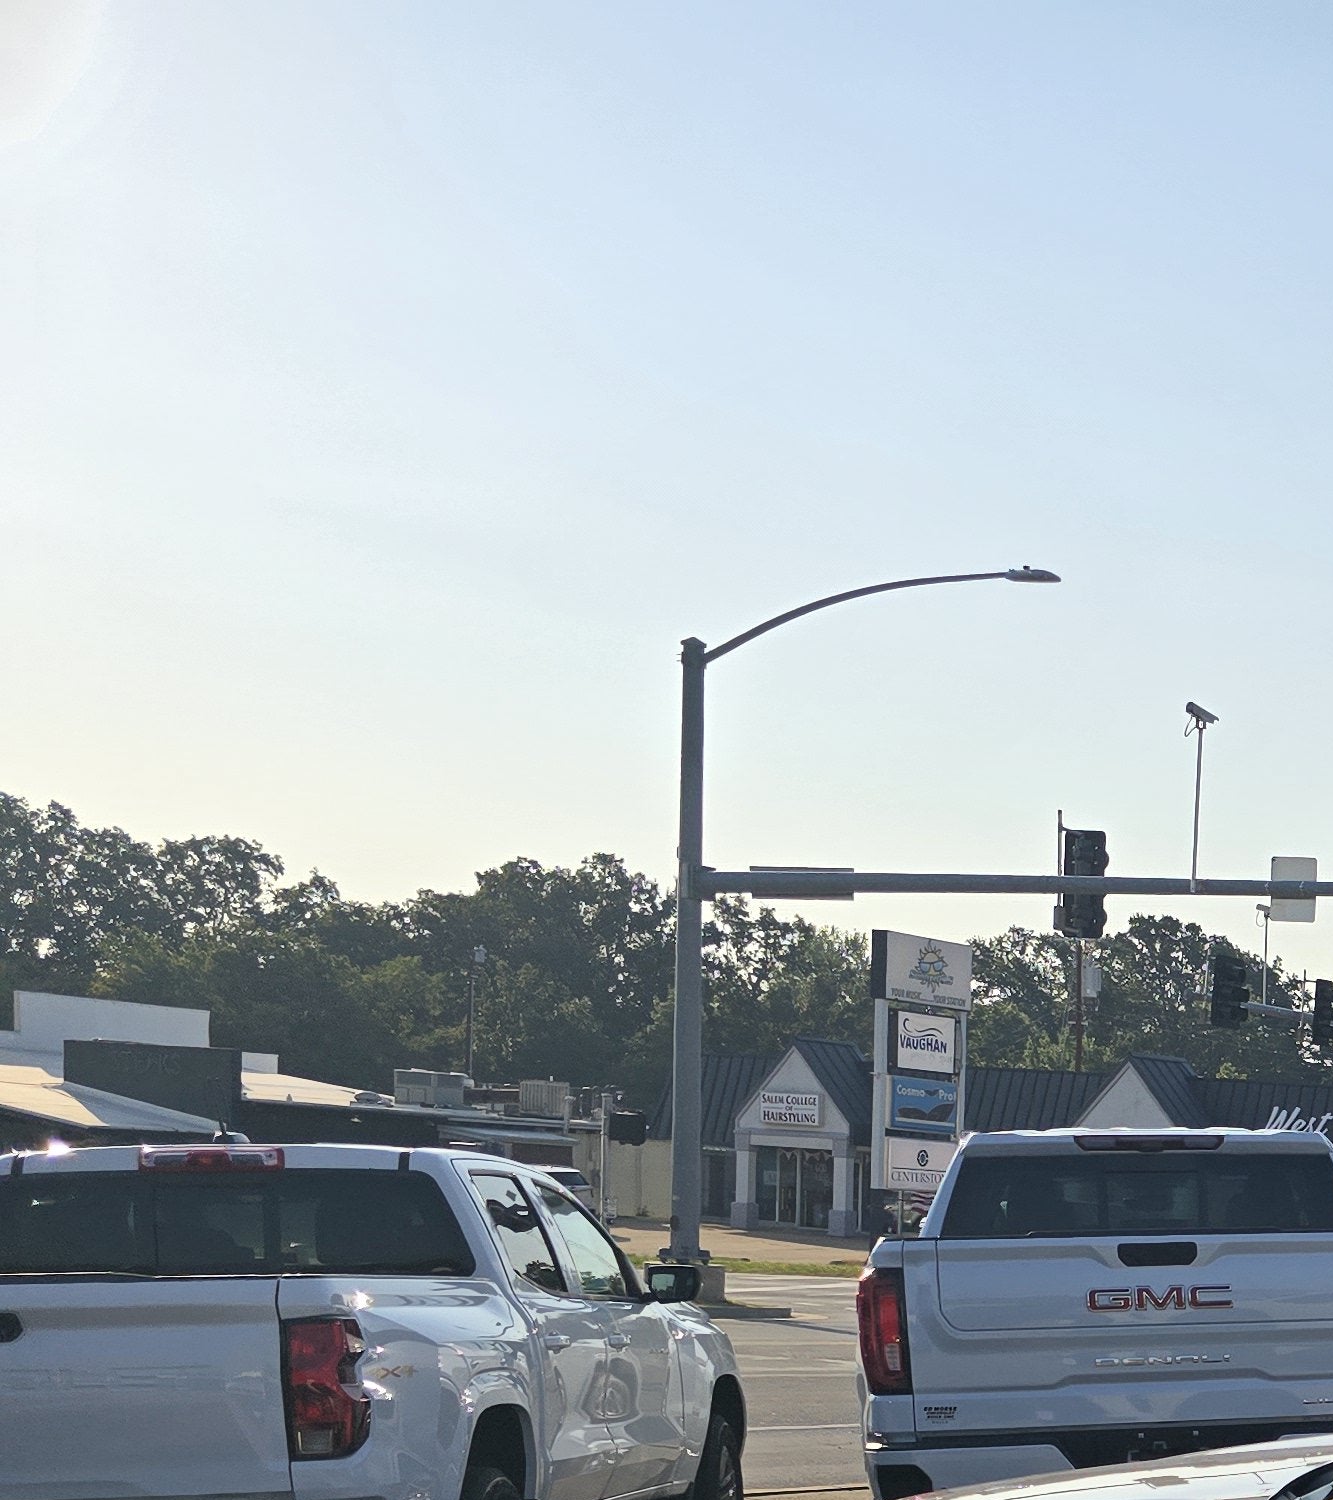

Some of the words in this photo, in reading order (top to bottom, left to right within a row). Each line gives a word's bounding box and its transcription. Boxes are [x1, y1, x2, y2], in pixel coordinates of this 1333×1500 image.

[899, 1033, 948, 1053] VAUGHAN
[896, 1084, 927, 1098] Cosmo
[762, 1093, 785, 1105] SALEM
[785, 1095, 817, 1107] COLLEGE
[763, 1110, 816, 1124] HAIRSTYLING
[1265, 1105, 1333, 1134] West
[1086, 1284, 1234, 1312] GMC
[1094, 1353, 1232, 1367] DENALI
